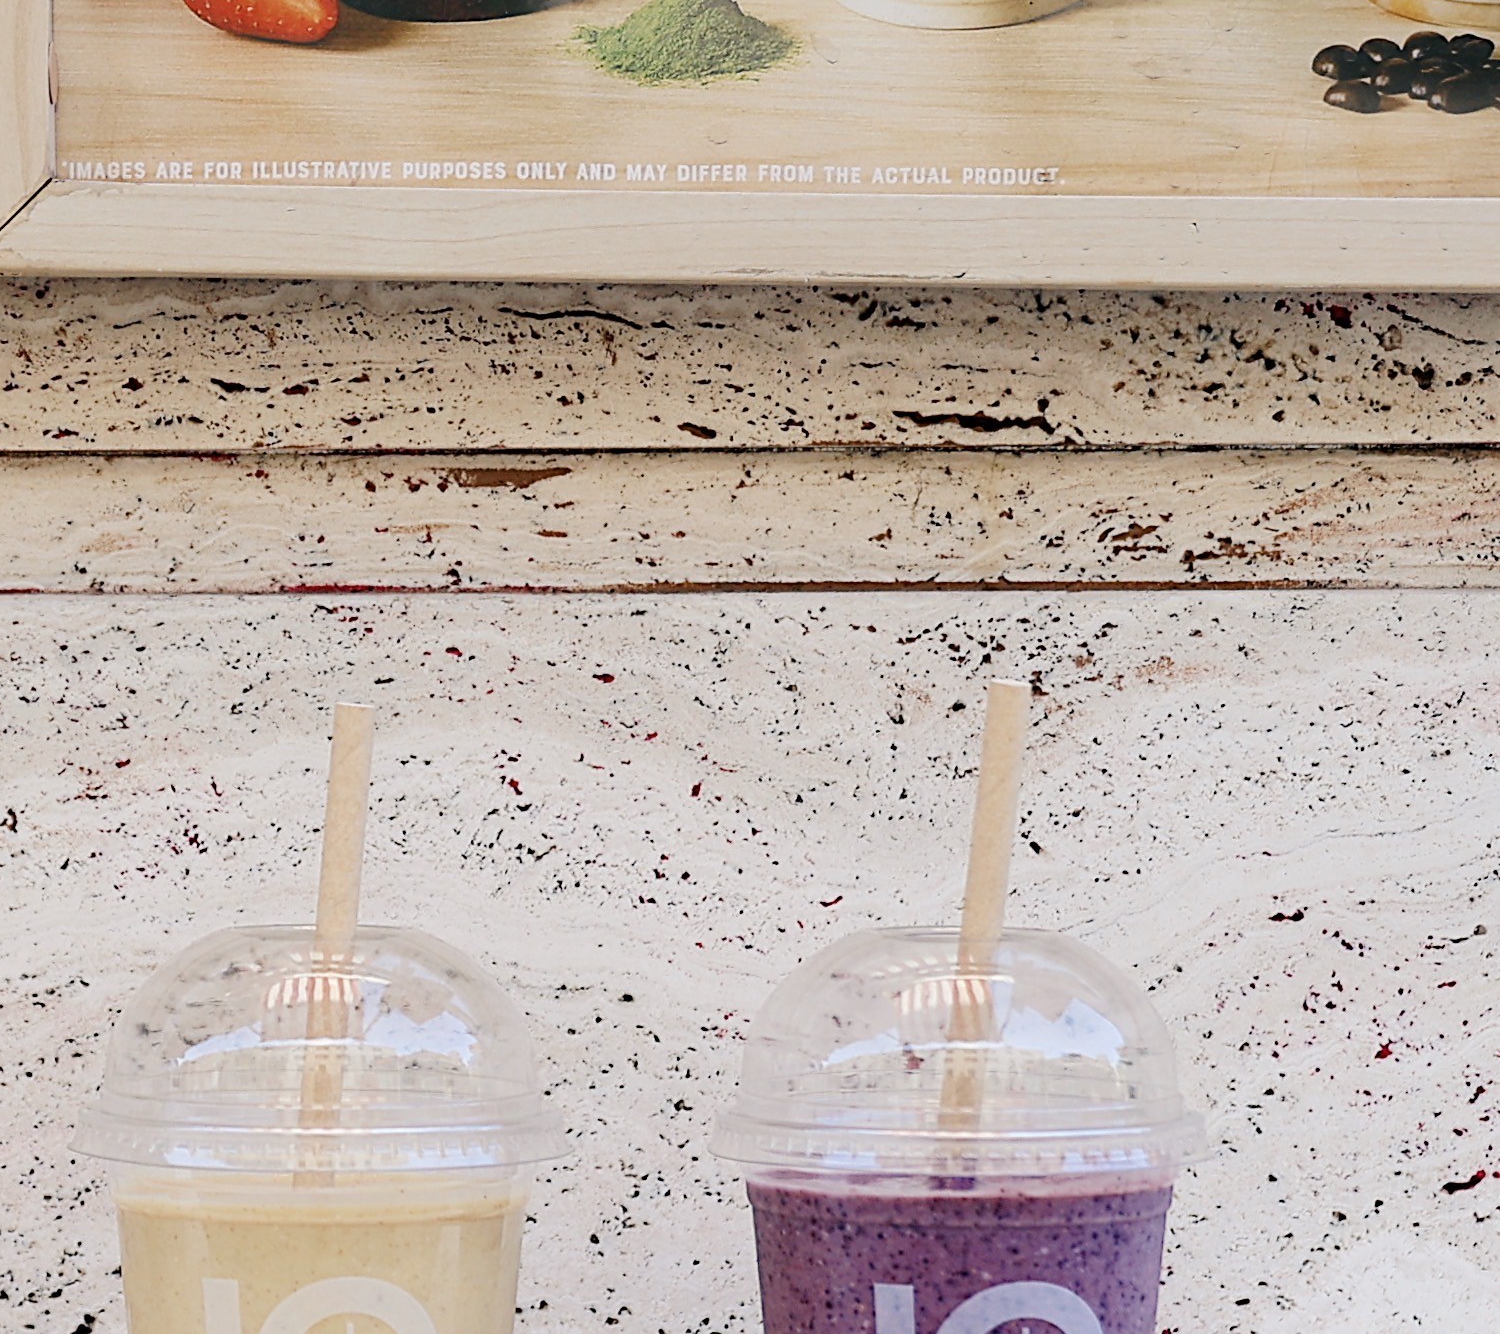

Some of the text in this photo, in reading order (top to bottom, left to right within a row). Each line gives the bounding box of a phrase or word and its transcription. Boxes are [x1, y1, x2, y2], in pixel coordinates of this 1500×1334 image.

[156, 162, 193, 180] ARE
[204, 162, 242, 180] FOR
[252, 160, 392, 181] ILLUSTRATIVE
[402, 162, 506, 181] PURPOSES
[516, 162, 567, 181] ONLY
[576, 163, 616, 181] AND
[626, 164, 667, 182] MAY
[677, 164, 748, 183] DIFFER
[758, 164, 814, 184] FROM
[824, 165, 861, 184] THE
[872, 166, 951, 185] ACTUAL
